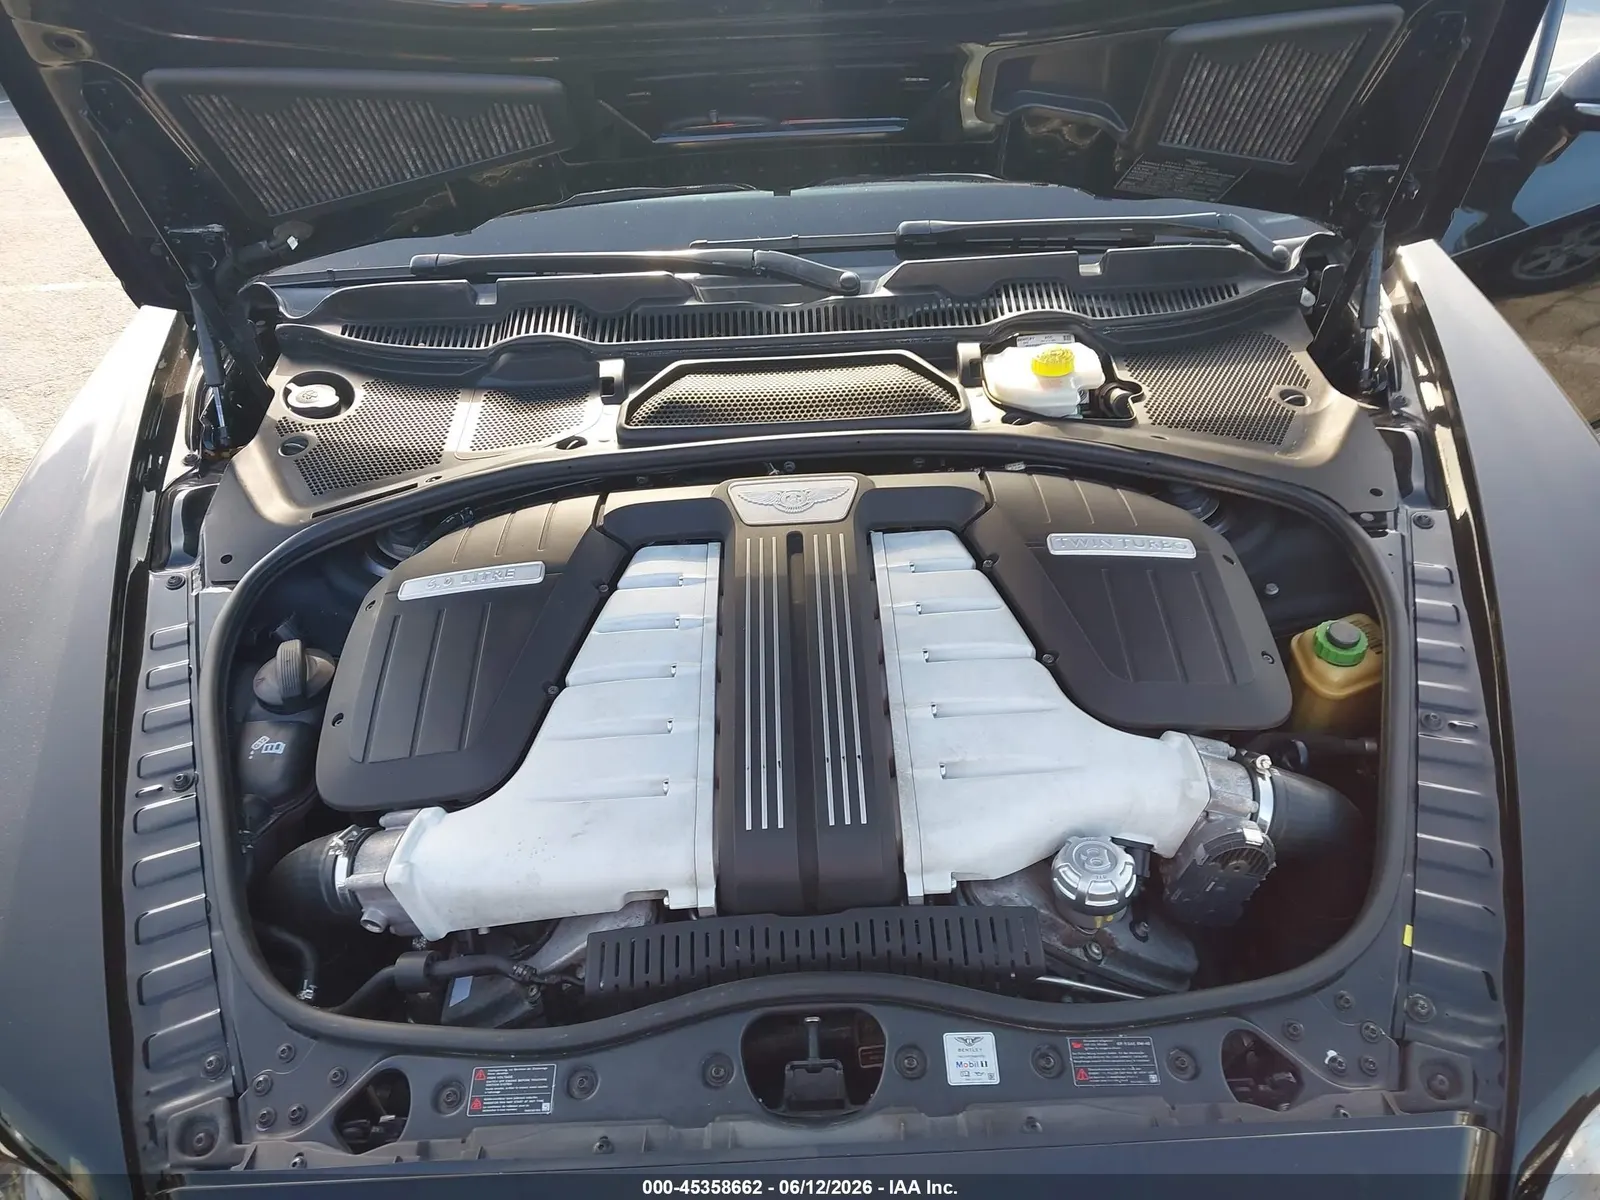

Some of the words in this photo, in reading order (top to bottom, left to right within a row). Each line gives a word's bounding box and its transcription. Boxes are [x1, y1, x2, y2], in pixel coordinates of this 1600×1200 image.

[1054, 536, 1115, 549] TWIN
[1117, 537, 1188, 551] TURBO
[459, 567, 517, 586] LITRE
[955, 1060, 980, 1069] Mobil
